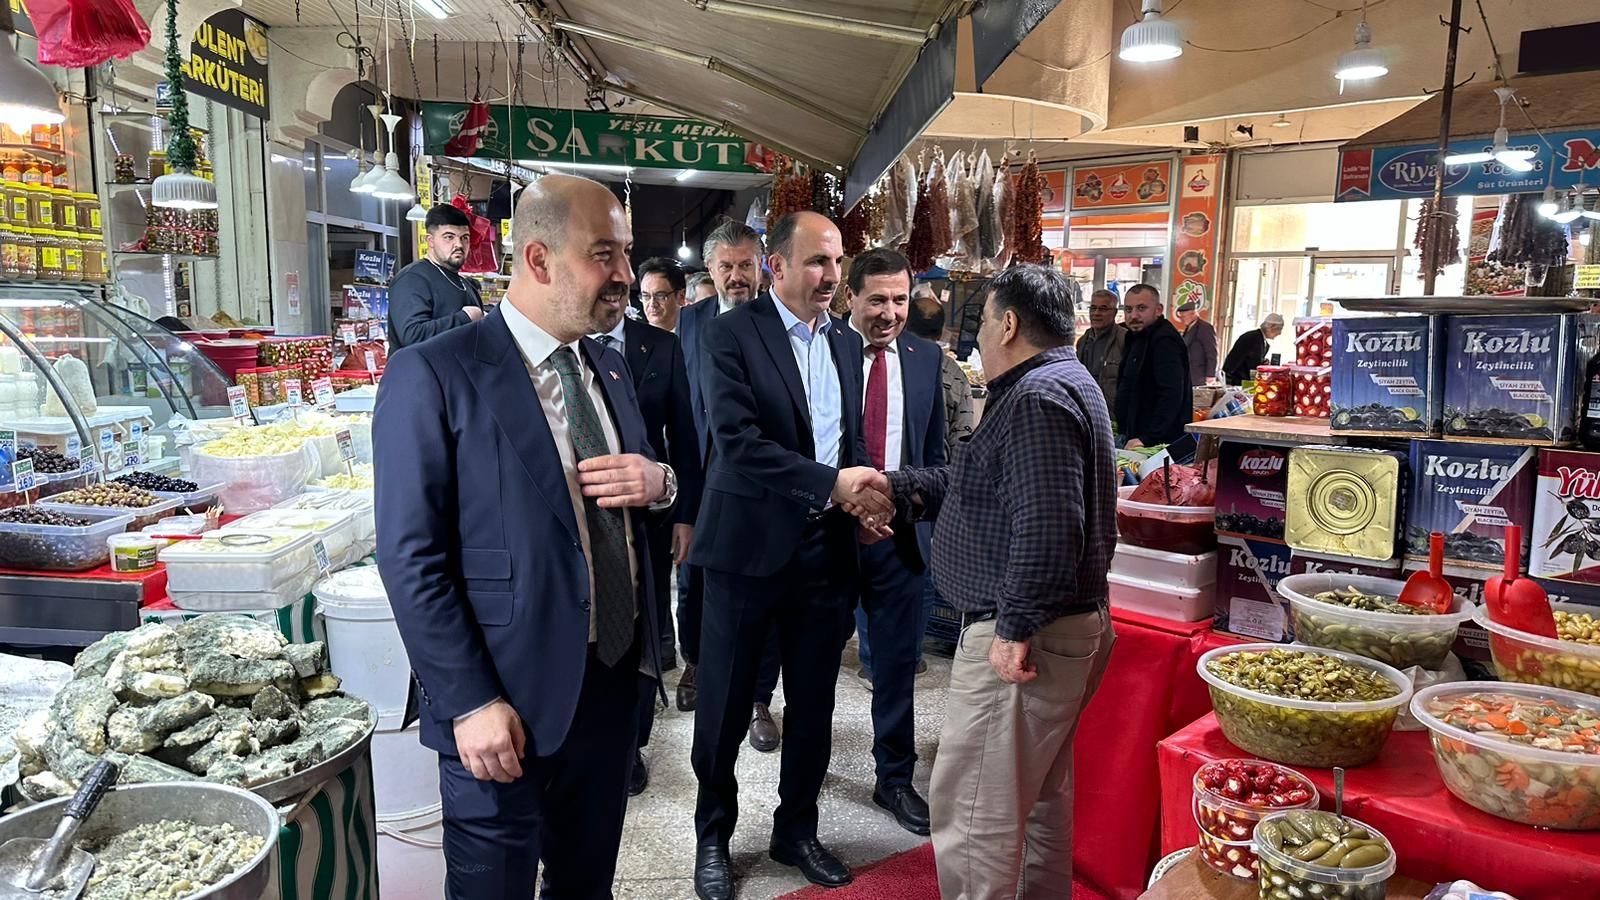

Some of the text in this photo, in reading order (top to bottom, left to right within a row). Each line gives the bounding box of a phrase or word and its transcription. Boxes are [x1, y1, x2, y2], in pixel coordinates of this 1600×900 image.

[672, 124, 744, 138] MERA
[1389, 161, 1462, 183] Riyae
[1345, 331, 1422, 353] Kozlu
[1463, 330, 1551, 354] Kozlu
[1357, 359, 1409, 369] Zeytincilik
[1475, 360, 1535, 371] Zeytincilik
[1239, 455, 1285, 471] kozlu
[1425, 455, 1510, 481] Kozlu
[1229, 549, 1291, 575] Kozlu
